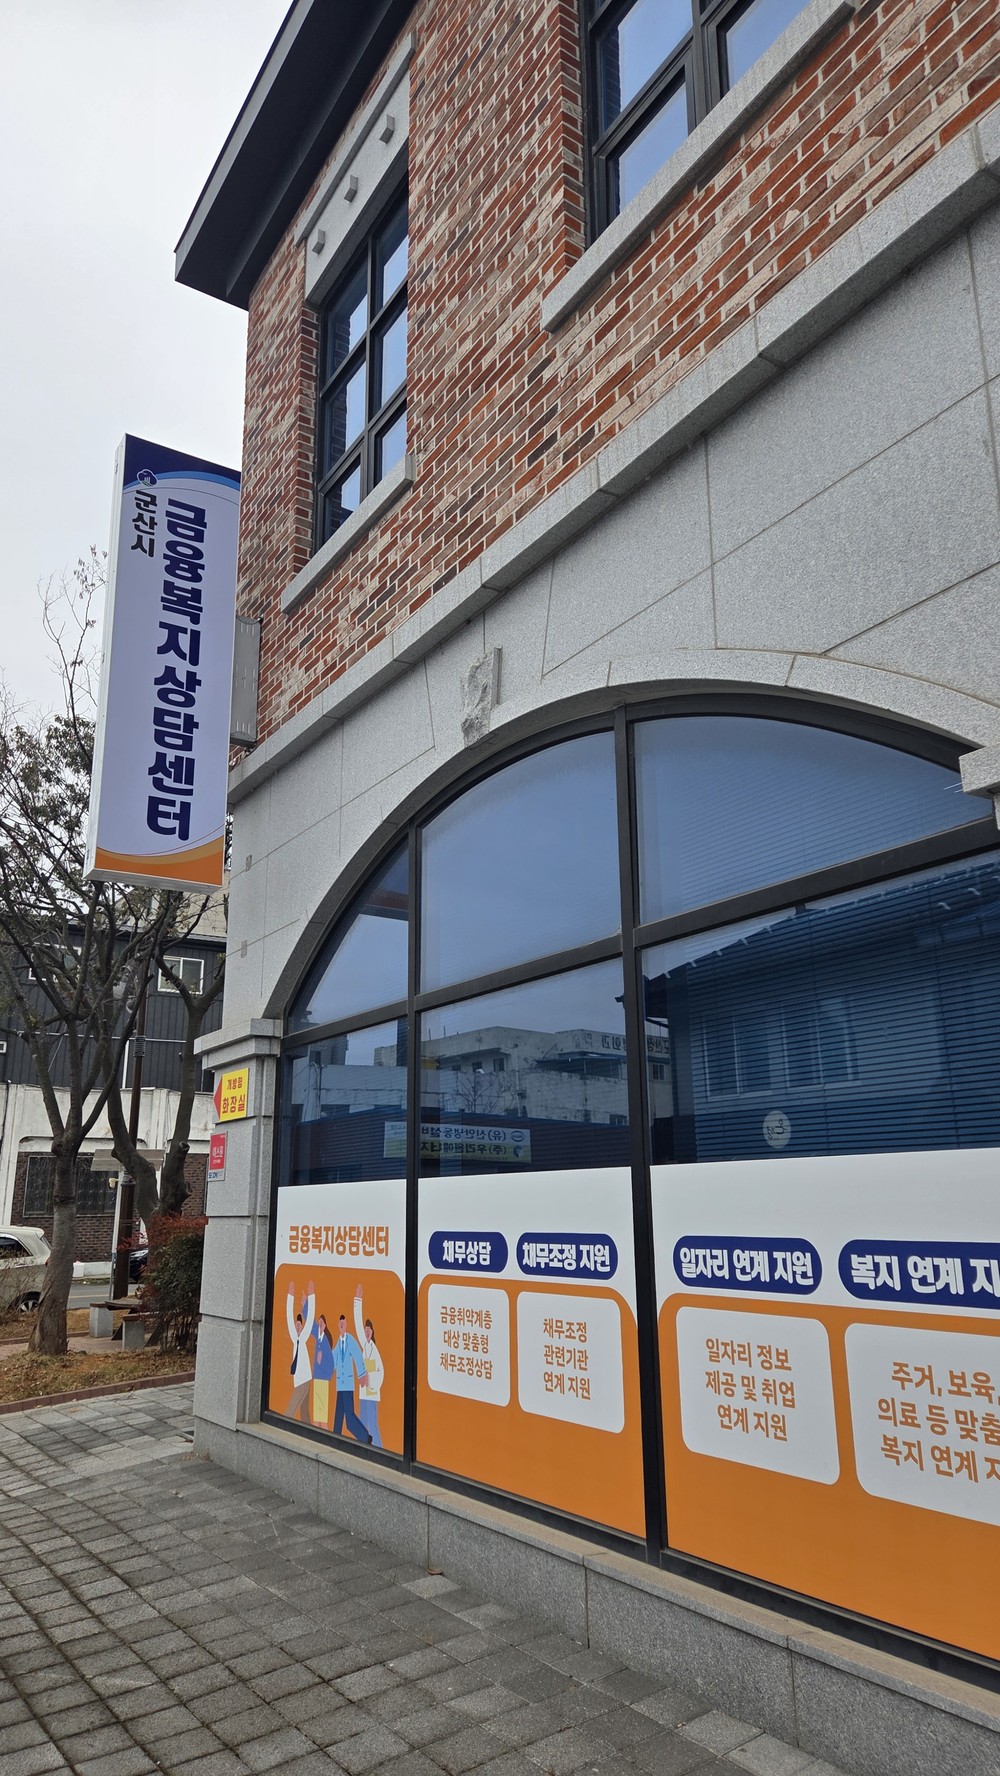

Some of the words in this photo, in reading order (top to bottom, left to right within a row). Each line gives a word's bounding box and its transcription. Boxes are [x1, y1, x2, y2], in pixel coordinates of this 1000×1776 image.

[131, 489, 158, 558] 군산시
[146, 497, 208, 841] 금융복지상담센터
[226, 1076, 242, 1090] 개방형
[222, 1094, 245, 1114] 화장실
[288, 1225, 390, 1257] 금융복지상담센터
[442, 1240, 492, 1265] 채무상담
[522, 1242, 576, 1272] 채무조정
[580, 1244, 611, 1272] 지원
[680, 1247, 730, 1280] 일자리
[732, 1249, 770, 1282] 연계
[773, 1252, 814, 1286] 지원
[850, 1254, 901, 1291] 복지
[906, 1255, 964, 1295] 연계
[440, 1306, 492, 1330] 금융취약계층
[543, 1318, 588, 1343] 채무조정
[443, 1330, 460, 1350] 대상
[462, 1332, 490, 1354] 맞춤형
[544, 1344, 589, 1372] 관련기관
[705, 1338, 752, 1368] 일자리
[756, 1344, 792, 1372] 정보
[440, 1352, 493, 1380] 채무조정상담
[892, 1361, 942, 1397] 주거,
[543, 1372, 565, 1394] 연계
[568, 1376, 591, 1400] 지원
[705, 1370, 736, 1398] 제공
[742, 1375, 758, 1402] 및
[761, 1379, 796, 1409] 취업
[716, 1404, 750, 1434] 연계
[753, 1409, 788, 1442] 지원
[878, 1397, 921, 1429] 의료
[926, 1404, 950, 1436] 등
[880, 1434, 924, 1472] 복지
[930, 1445, 978, 1484] 연계
